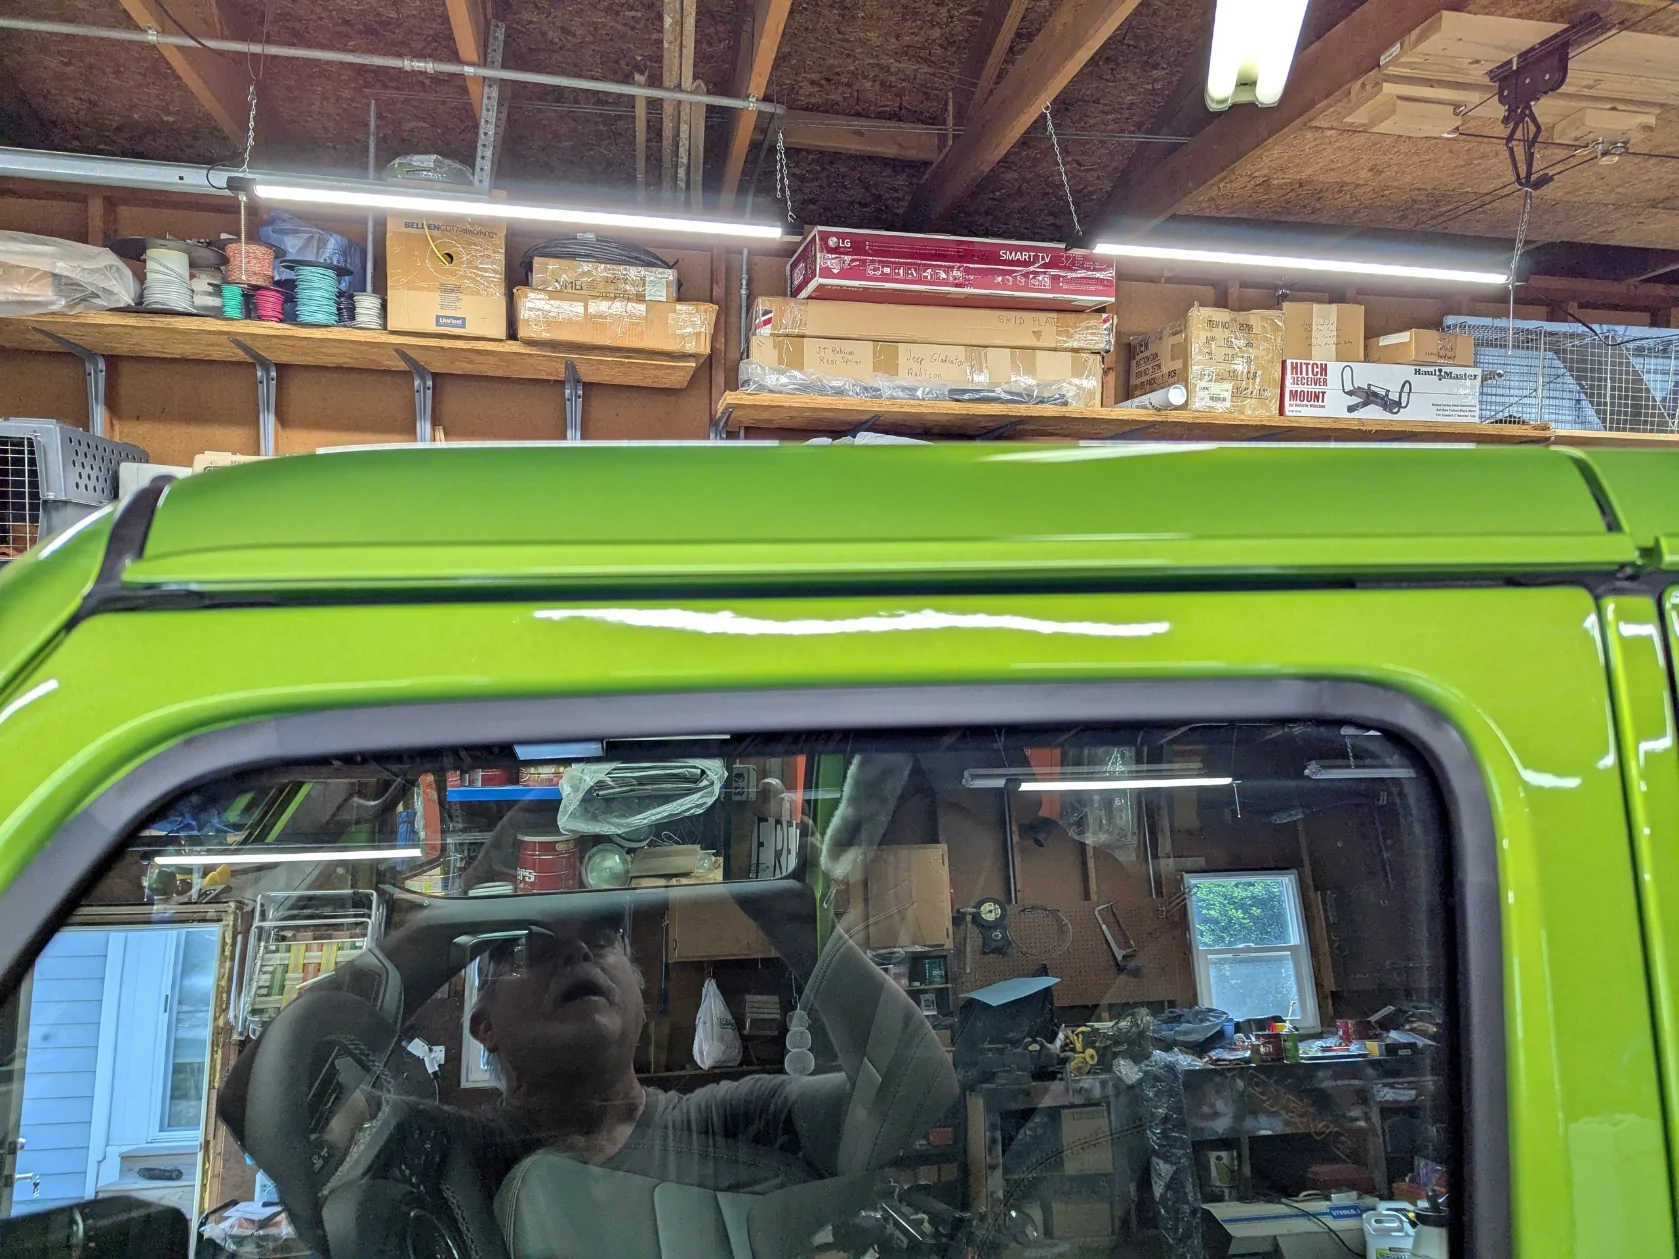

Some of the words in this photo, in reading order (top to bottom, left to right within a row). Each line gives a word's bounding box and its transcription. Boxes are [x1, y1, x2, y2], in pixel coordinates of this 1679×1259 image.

[839, 238, 851, 247] LG
[1000, 250, 1035, 262] SMART
[1037, 253, 1051, 263] TV
[906, 349, 925, 365] Jeep
[930, 352, 965, 367] Gladiator
[1290, 361, 1328, 377] HITCH
[1414, 368, 1437, 377] Haul
[1442, 371, 1478, 381] Master
[1290, 376, 1328, 387] RECEIVER
[1289, 389, 1327, 403] MOUNT
